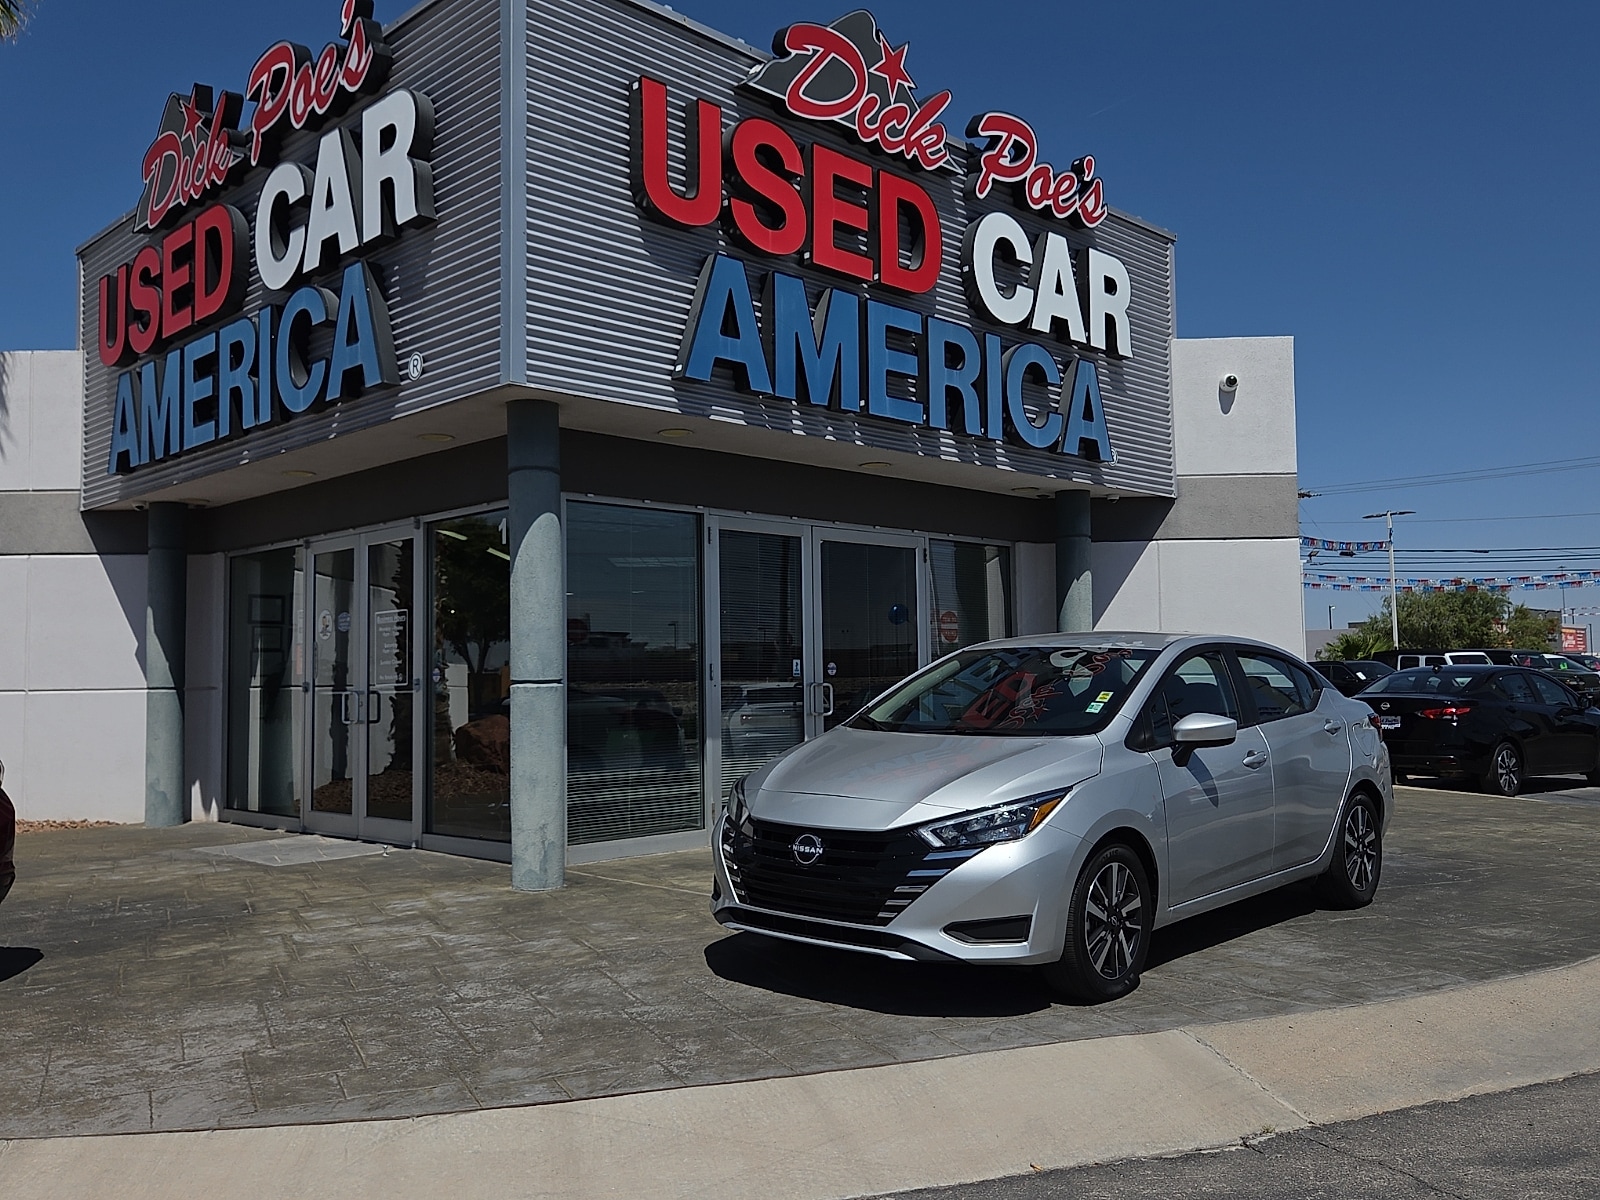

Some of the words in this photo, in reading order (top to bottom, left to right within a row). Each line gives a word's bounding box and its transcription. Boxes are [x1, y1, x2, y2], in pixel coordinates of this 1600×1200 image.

[142, 89, 234, 229] Dick
[247, 0, 373, 167] Poe's
[641, 76, 943, 295] USED
[972, 212, 1134, 358] CAR
[785, 22, 952, 171] Dick
[974, 111, 1108, 229] Poe's
[98, 204, 234, 367] USED
[255, 88, 417, 291] CAR
[107, 260, 383, 475] AMERICA
[686, 254, 1116, 463] AMERICA
[792, 844, 824, 855] NISSAN
